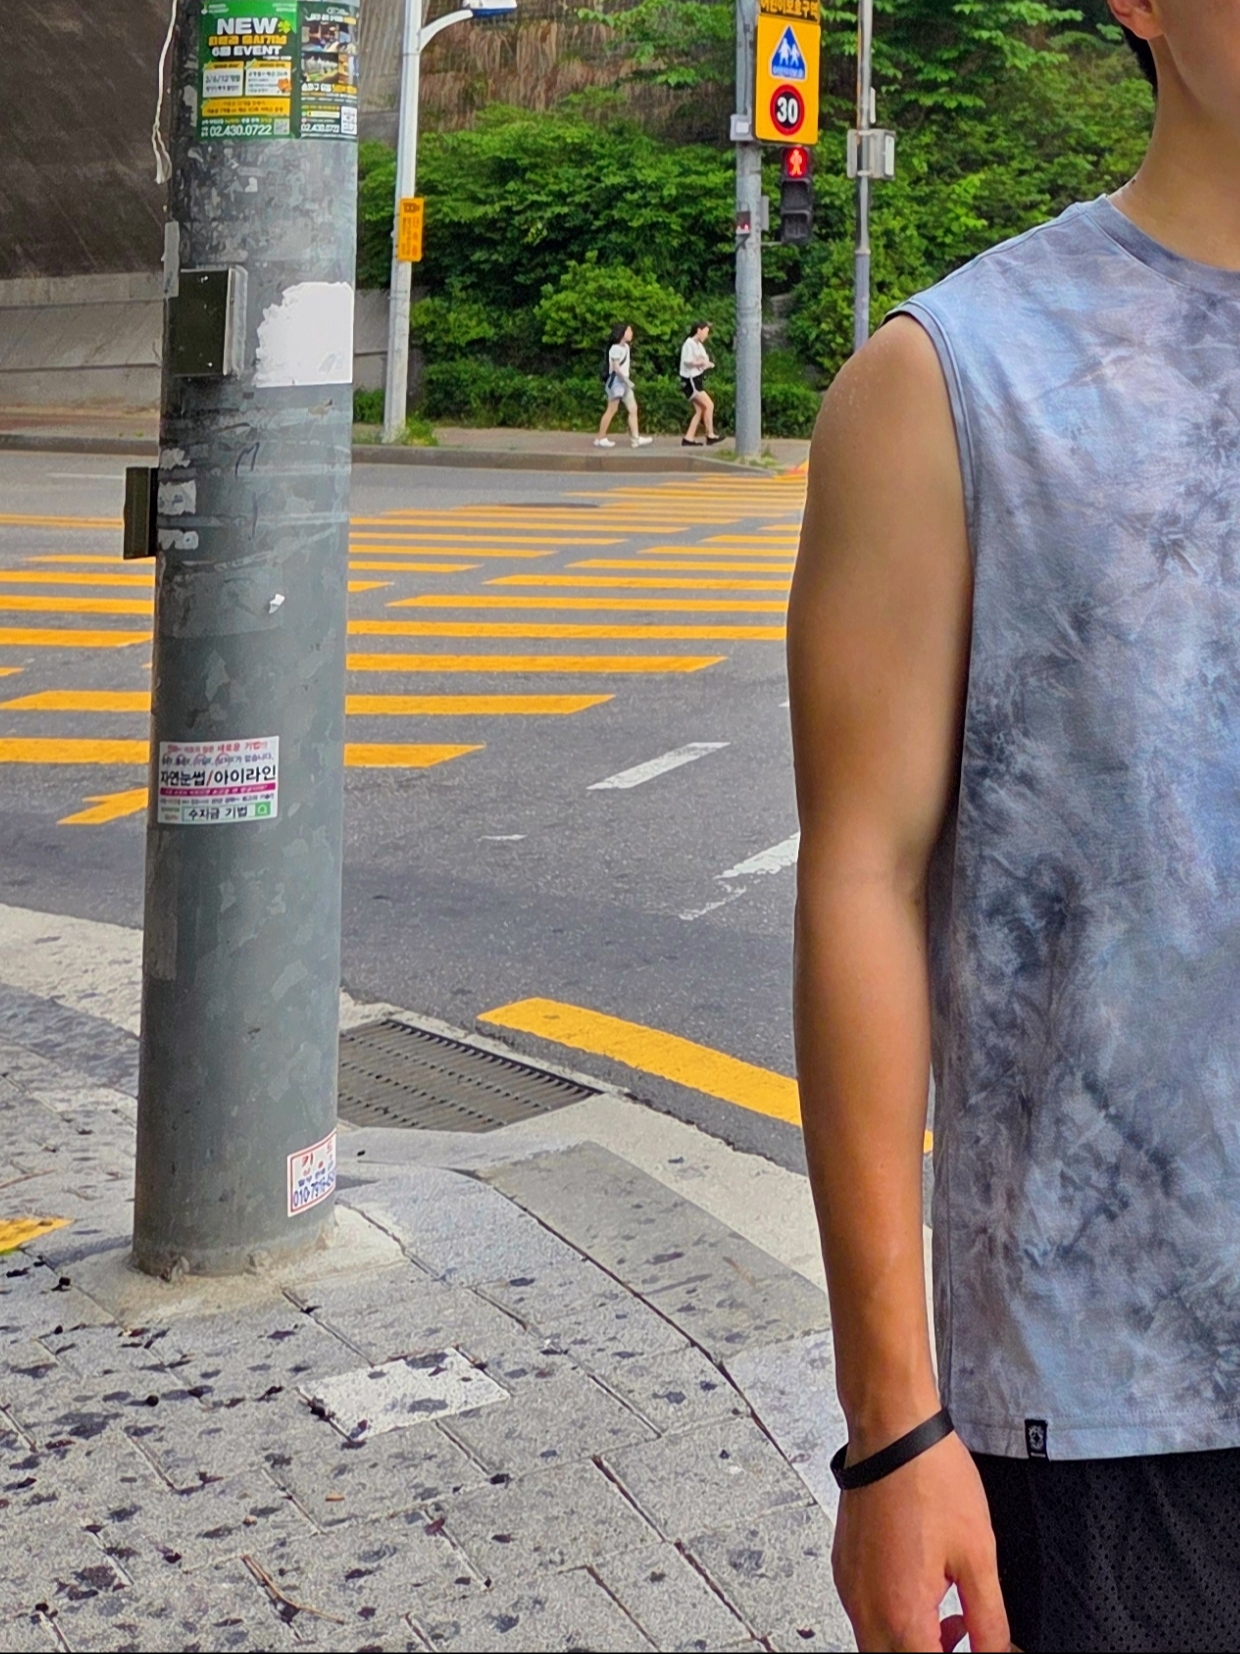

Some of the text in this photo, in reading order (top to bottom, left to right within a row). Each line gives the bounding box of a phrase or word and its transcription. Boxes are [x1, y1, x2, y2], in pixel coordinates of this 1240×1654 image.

[216, 16, 278, 35] NEW
[232, 44, 282, 56] EVENT
[775, 95, 798, 123] 30
[209, 123, 272, 137] 02.430.0722
[159, 764, 276, 786] 자연눈썹/아이라인
[224, 805, 248, 817] 기법
